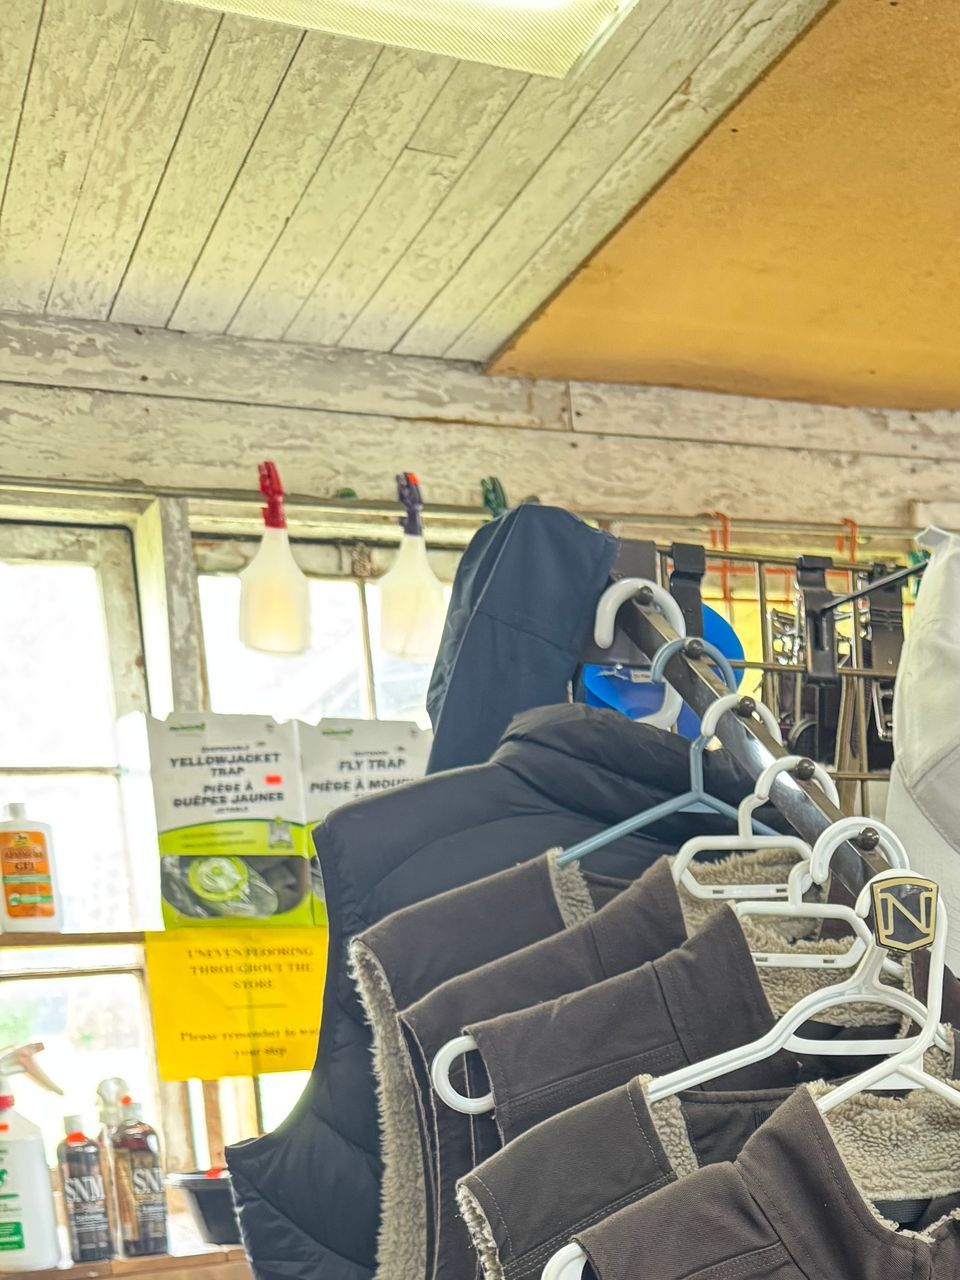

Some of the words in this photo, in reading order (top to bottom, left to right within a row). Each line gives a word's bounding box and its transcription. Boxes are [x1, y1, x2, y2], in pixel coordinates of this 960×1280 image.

[170, 753, 281, 768] YELLOWJACKET
[339, 760, 365, 772] FLY
[368, 758, 406, 770] TRAP
[211, 767, 245, 778] TRAP
[231, 792, 284, 804] JAUNES
[133, 1167, 164, 1194] SN
